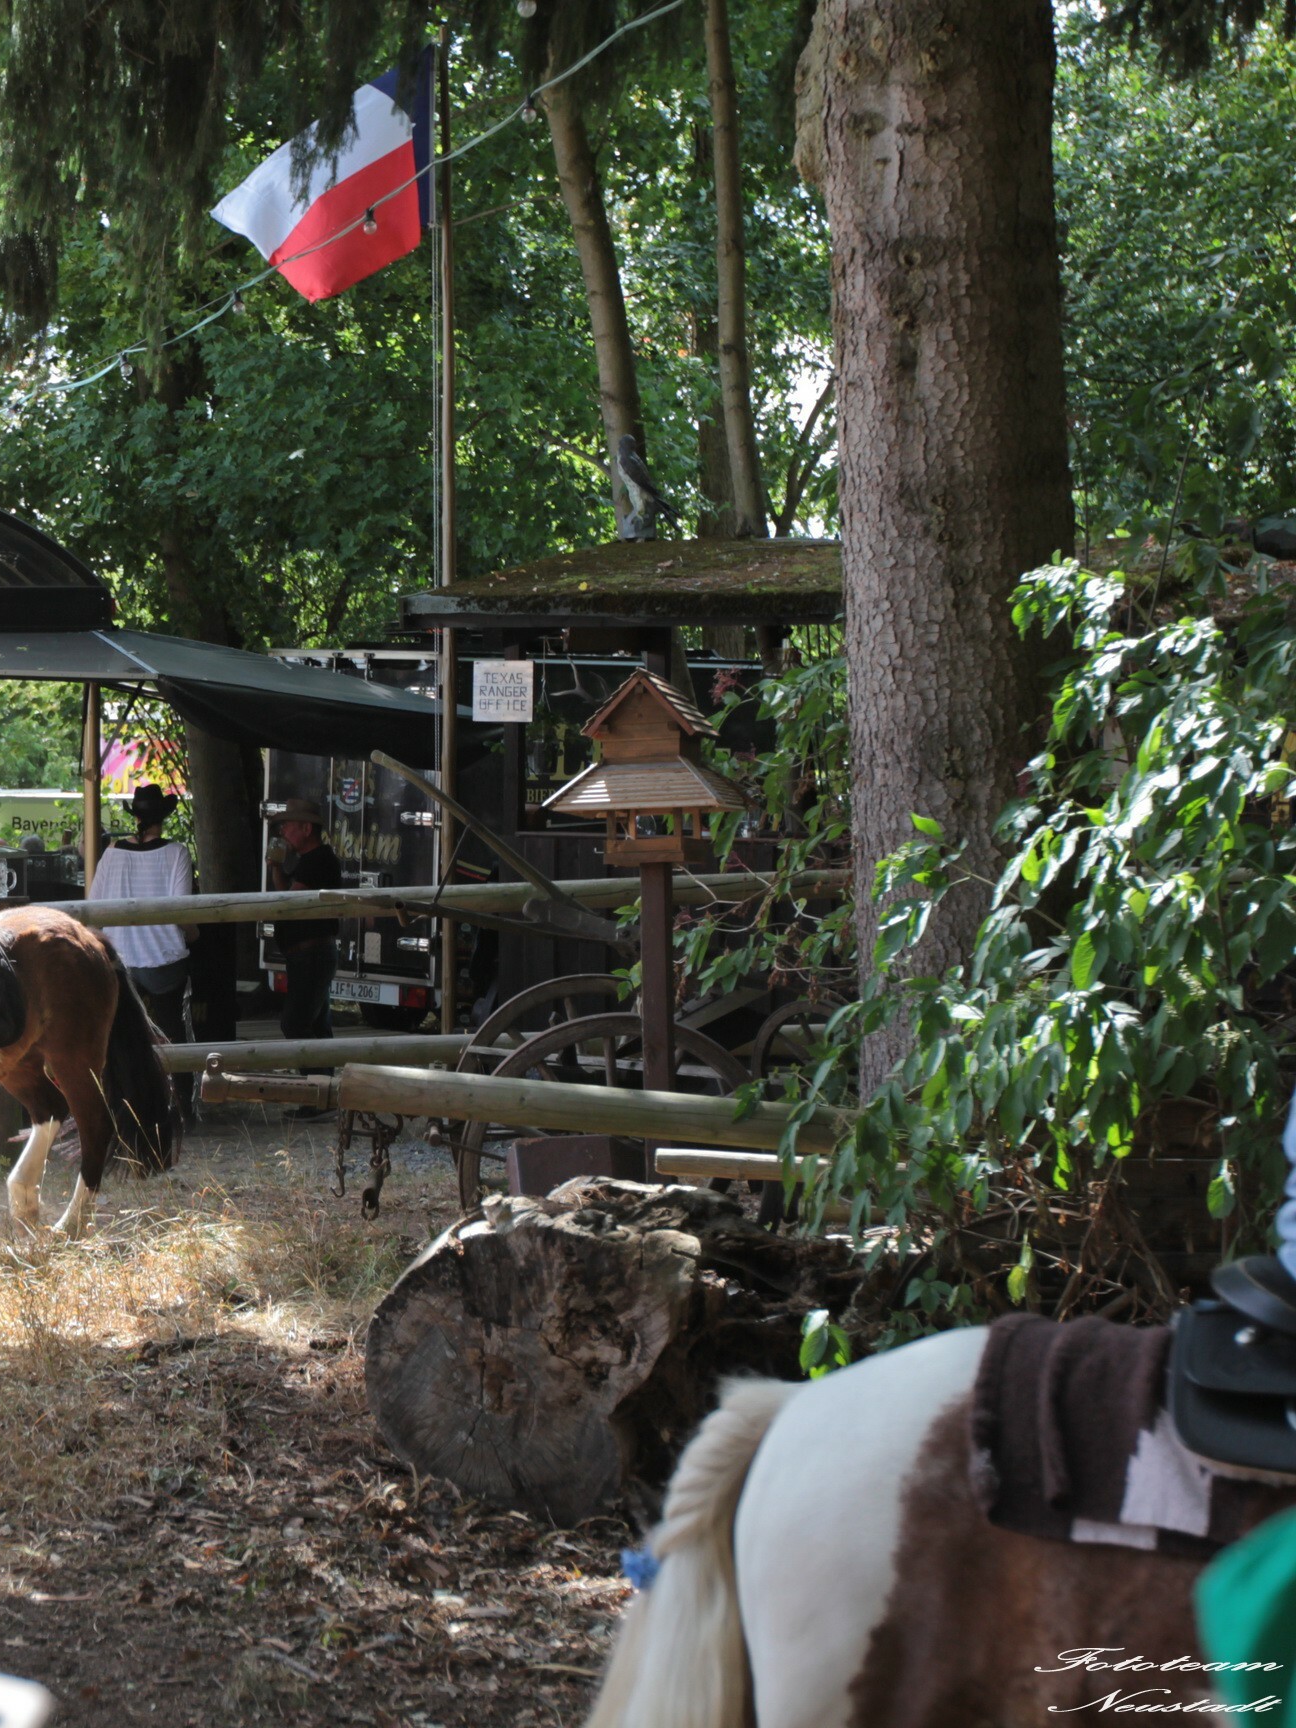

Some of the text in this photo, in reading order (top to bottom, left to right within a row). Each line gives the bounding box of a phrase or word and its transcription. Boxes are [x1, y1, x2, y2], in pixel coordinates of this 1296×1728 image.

[484, 672, 523, 684] TEXAS
[479, 685, 528, 698] RANGER
[479, 698, 528, 711] OFFICE
[358, 984, 373, 998] 206
